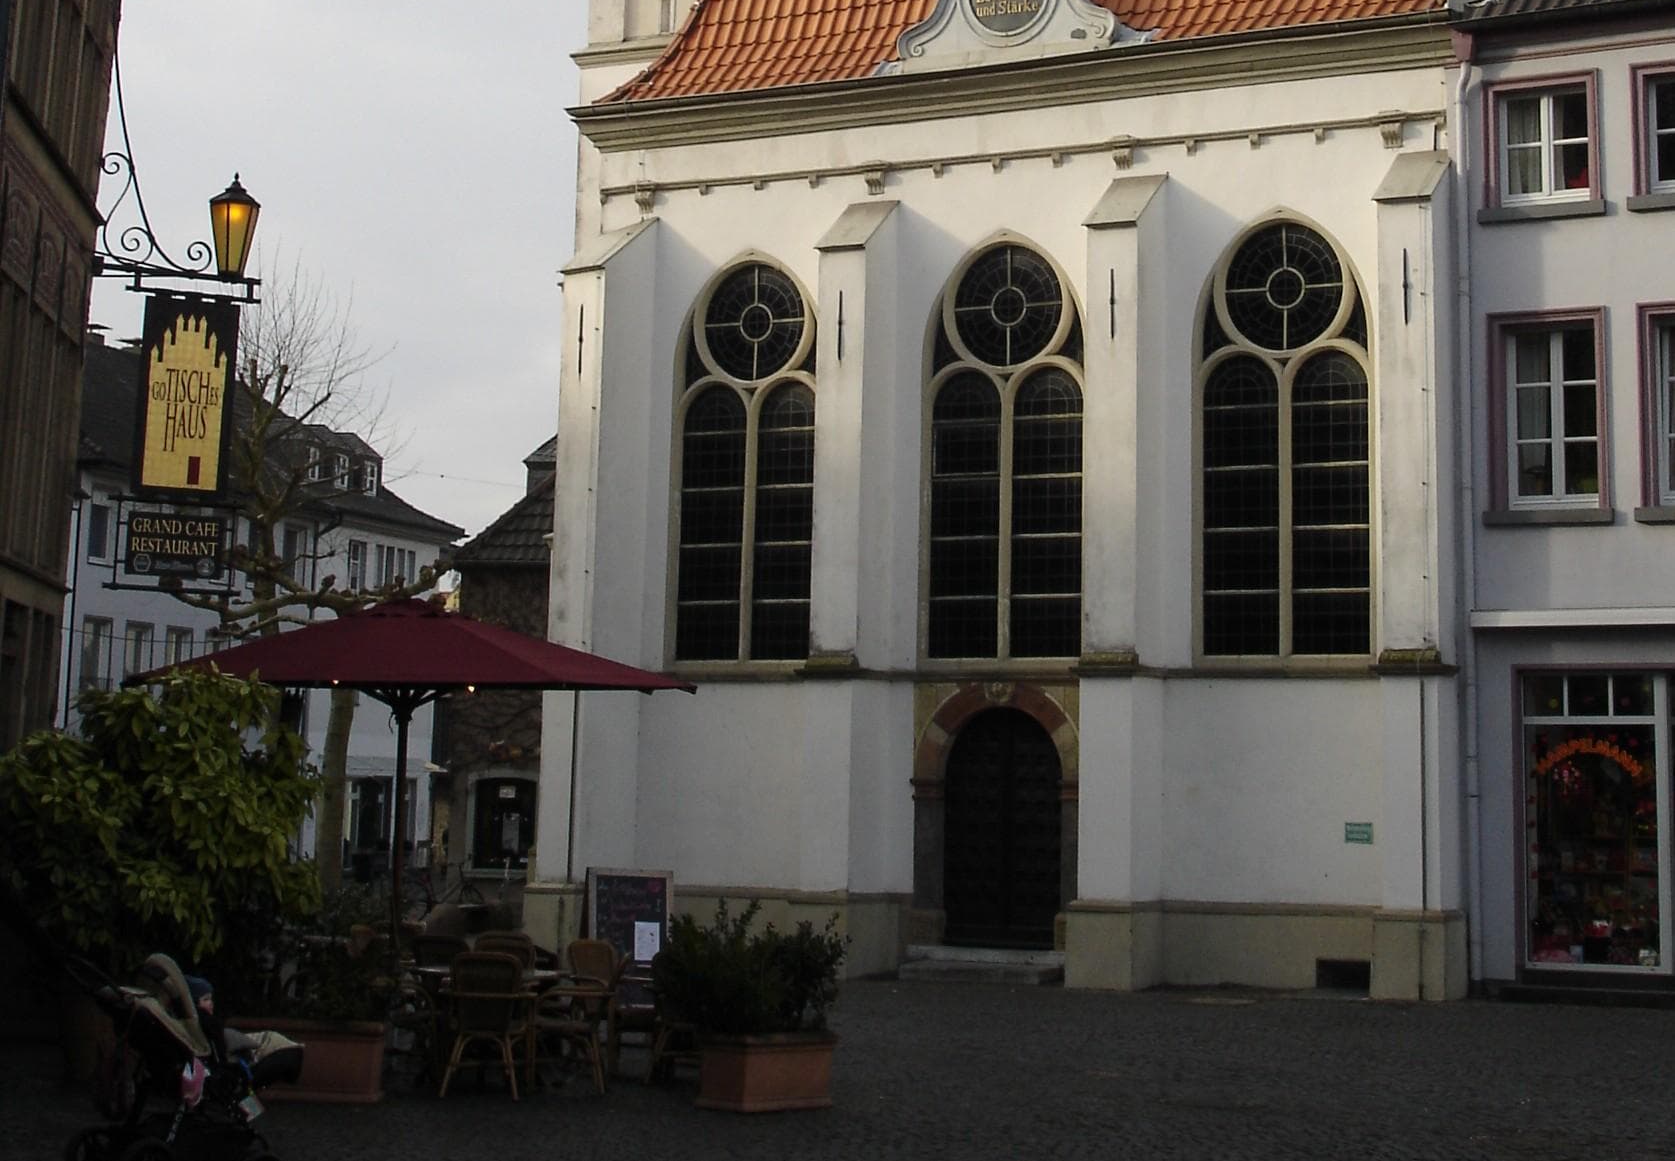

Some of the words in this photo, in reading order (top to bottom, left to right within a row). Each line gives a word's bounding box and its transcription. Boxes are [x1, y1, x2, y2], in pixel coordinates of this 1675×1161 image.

[976, 1, 996, 17] und
[998, 0, 1038, 14] Stärke
[162, 402, 208, 452] HAUS
[132, 517, 182, 535] GRAND
[131, 536, 219, 557] RESTAURANT
